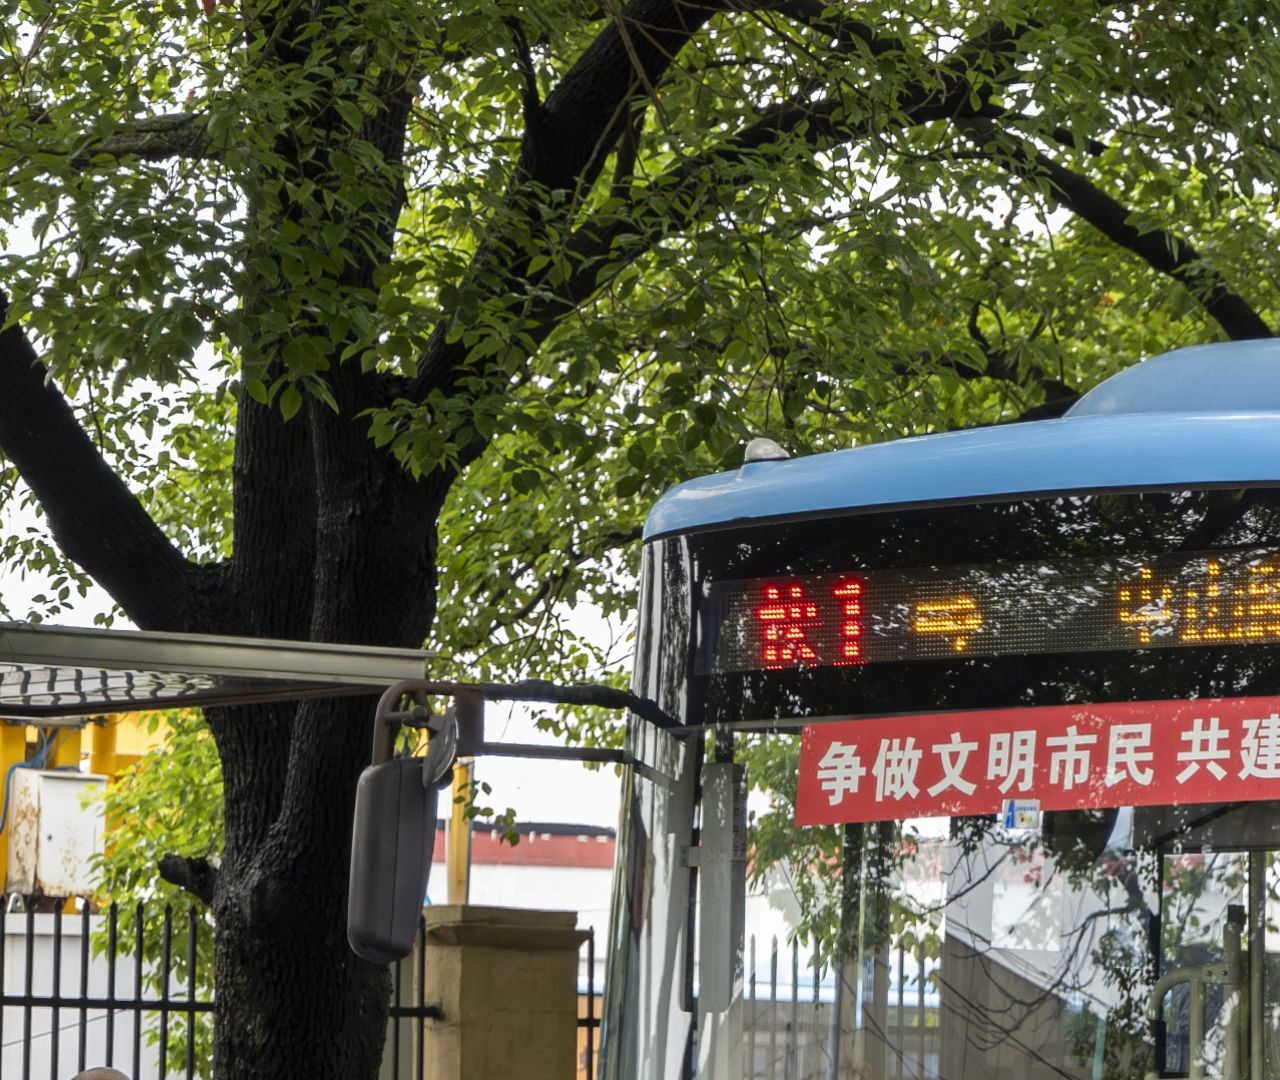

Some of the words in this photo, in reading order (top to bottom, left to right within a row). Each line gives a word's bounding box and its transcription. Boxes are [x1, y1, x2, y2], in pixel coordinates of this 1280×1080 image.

[816, 722, 1153, 805] 争做文明市民
